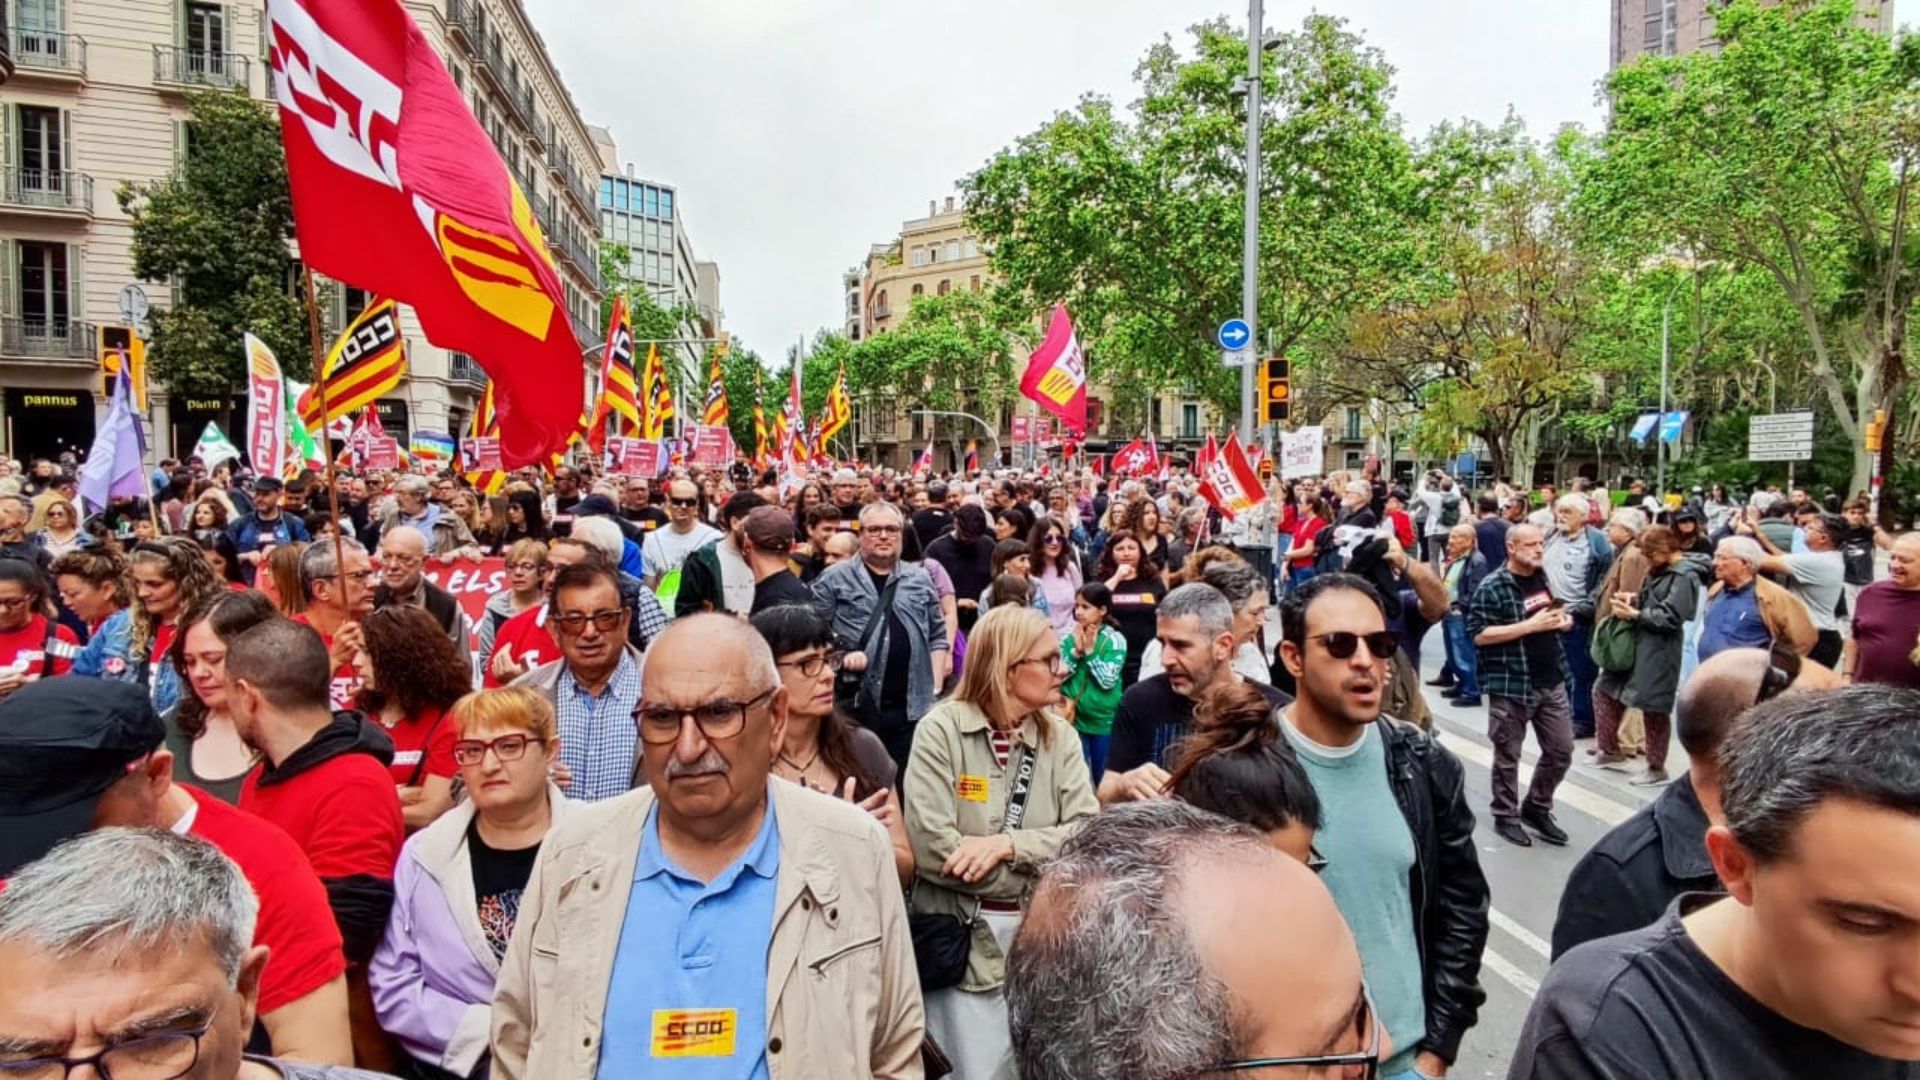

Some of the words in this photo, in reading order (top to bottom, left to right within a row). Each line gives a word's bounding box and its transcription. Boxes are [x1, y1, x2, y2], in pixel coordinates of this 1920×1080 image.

[24, 394, 78, 407] pannus
[186, 399, 237, 411] panns
[446, 569, 507, 595] ELS
[1015, 755, 1033, 794] LOLA
[667, 1021, 723, 1036] CCOO
